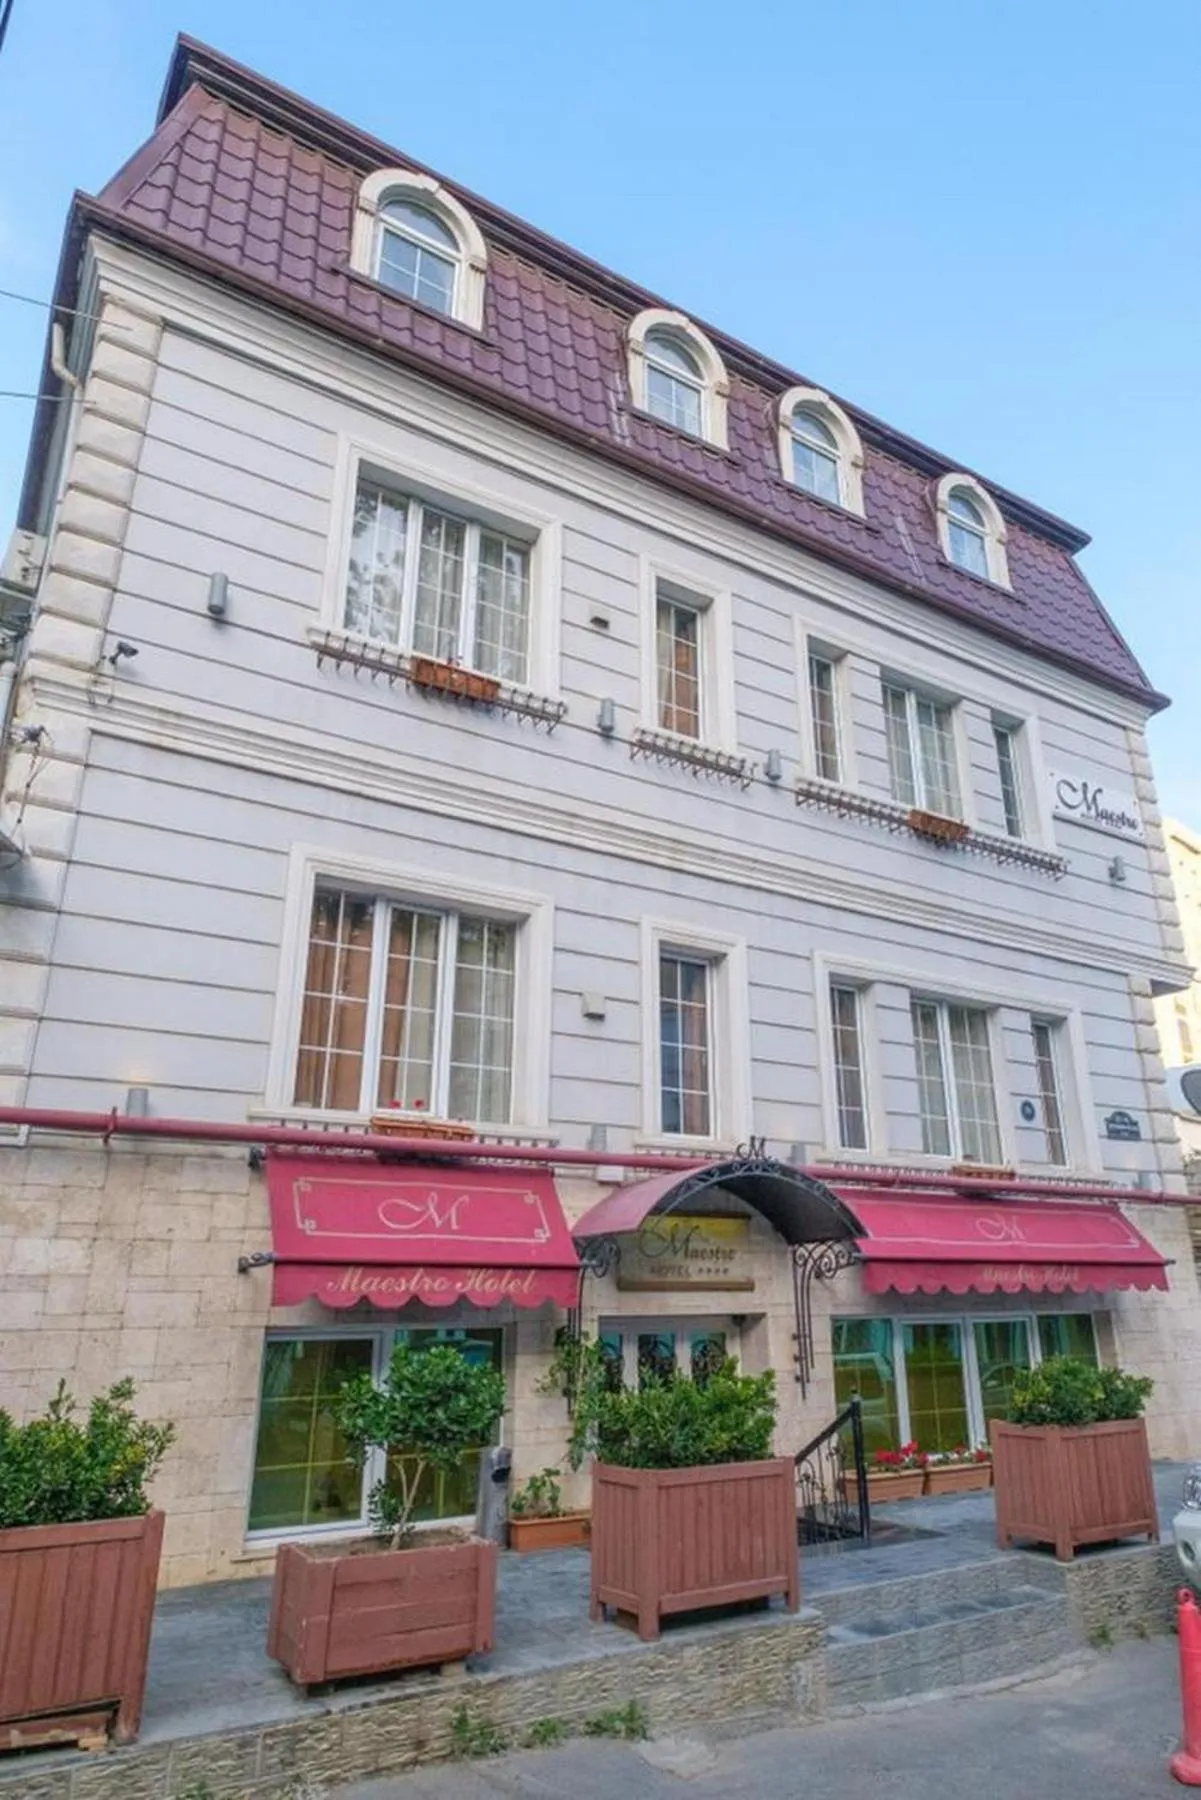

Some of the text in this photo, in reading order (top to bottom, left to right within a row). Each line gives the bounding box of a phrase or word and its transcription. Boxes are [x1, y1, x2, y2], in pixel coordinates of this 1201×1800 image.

[1056, 779, 1138, 830] Maestro
[377, 1192, 470, 1230] M
[638, 1223, 737, 1263] Maestro
[326, 1267, 538, 1294] Maestro Hotel
